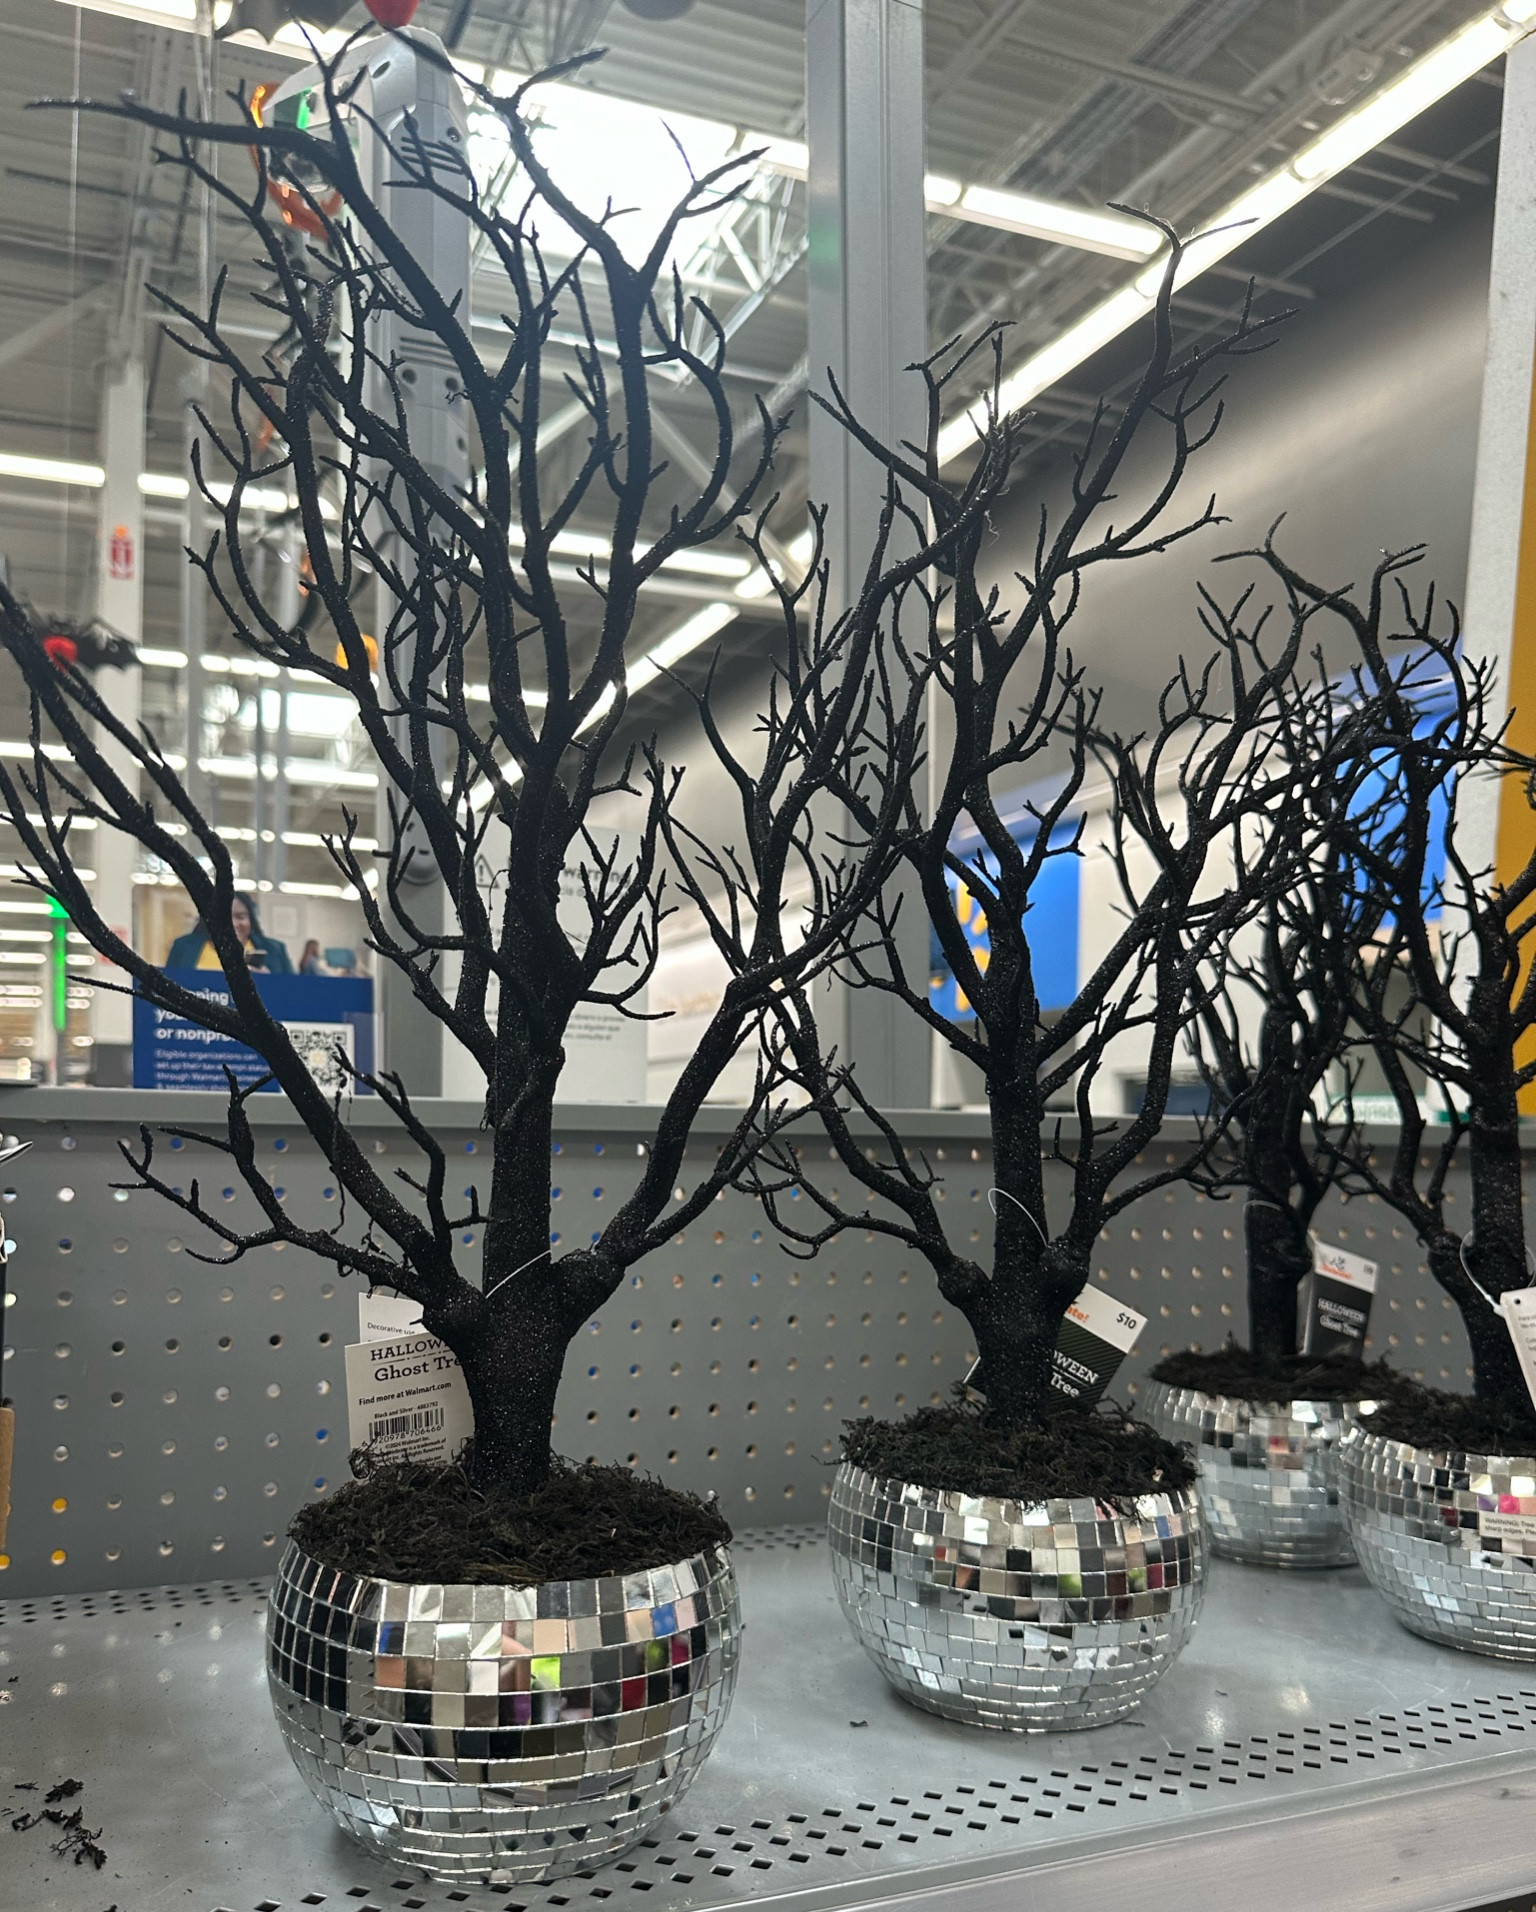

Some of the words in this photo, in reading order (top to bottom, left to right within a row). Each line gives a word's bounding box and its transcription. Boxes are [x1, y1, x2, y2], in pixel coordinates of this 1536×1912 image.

[155, 1008, 188, 1023] yo
[155, 1028, 173, 1039] or
[174, 1028, 236, 1044] nonpro
[1317, 1297, 1367, 1322] HALLOWEEN
[367, 1321, 403, 1335] Decorative
[1116, 1312, 1137, 1330] $10
[370, 1339, 450, 1361] HALLOW
[374, 1361, 430, 1382] Ghost
[433, 1356, 461, 1371] Tre
[359, 1397, 375, 1406] Find
[376, 1393, 395, 1402] more
[396, 1391, 404, 1399] at
[405, 1382, 452, 1397] Walmart.com
[1050, 1371, 1080, 1399] Tree
[374, 1410, 388, 1419] Black
[388, 1408, 398, 1416] and
[399, 1406, 414, 1414] Silver
[374, 1432, 406, 1445] 20978
[409, 1424, 442, 1438] 706466
